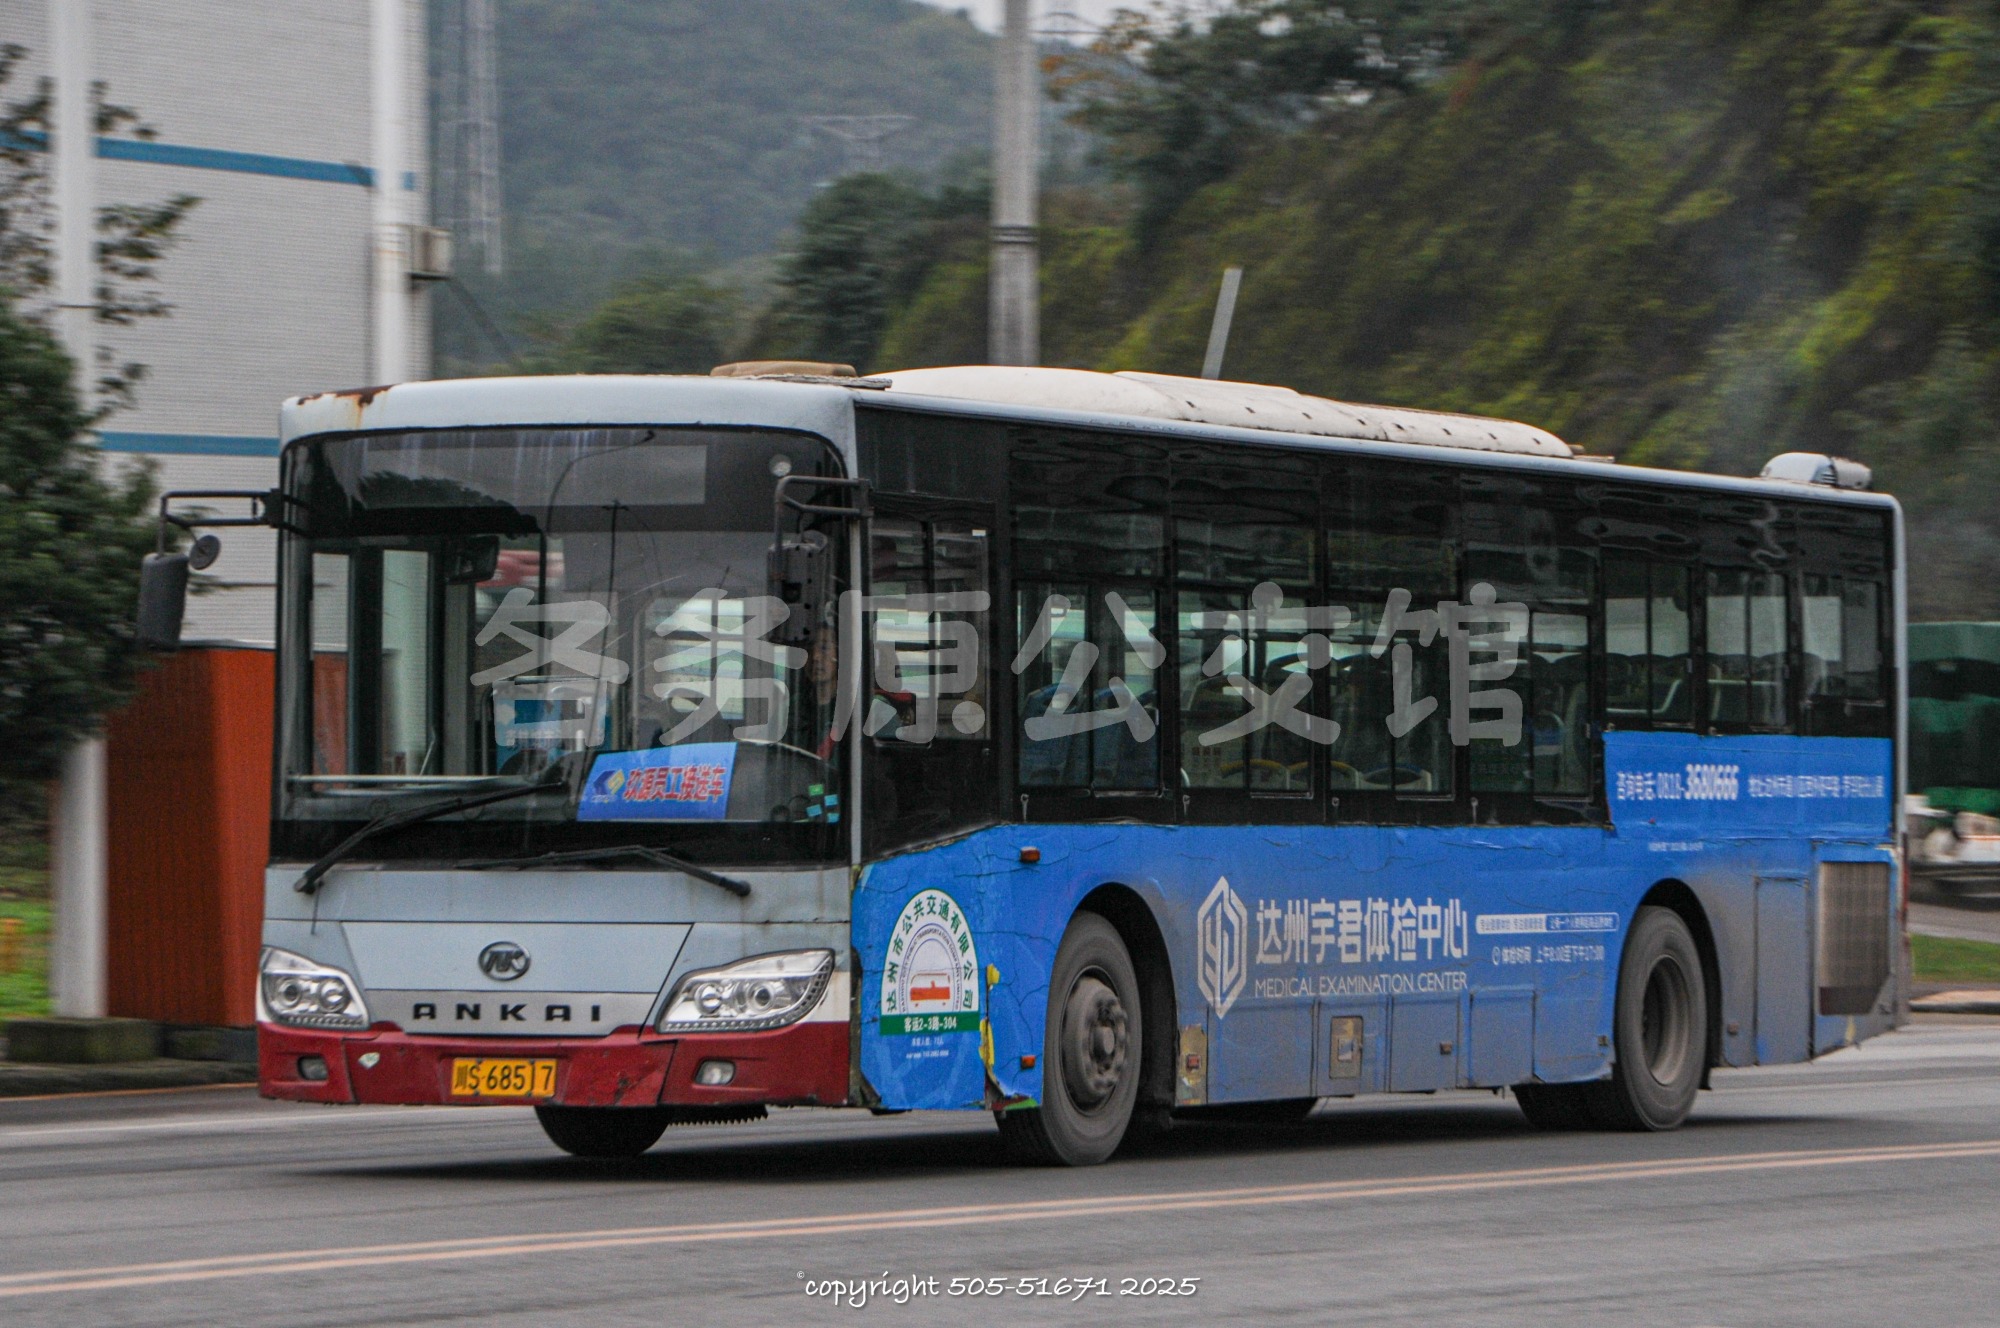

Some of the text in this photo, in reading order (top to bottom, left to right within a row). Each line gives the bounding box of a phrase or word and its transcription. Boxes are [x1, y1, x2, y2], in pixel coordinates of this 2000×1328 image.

[886, 895, 973, 1012] 达州市公共交通有限公司
[1256, 897, 1468, 964] 达州宇君体检中心
[1255, 971, 1468, 998] MEDICAL EXAMINATION CENTER
[413, 1003, 601, 1021] ANKAI
